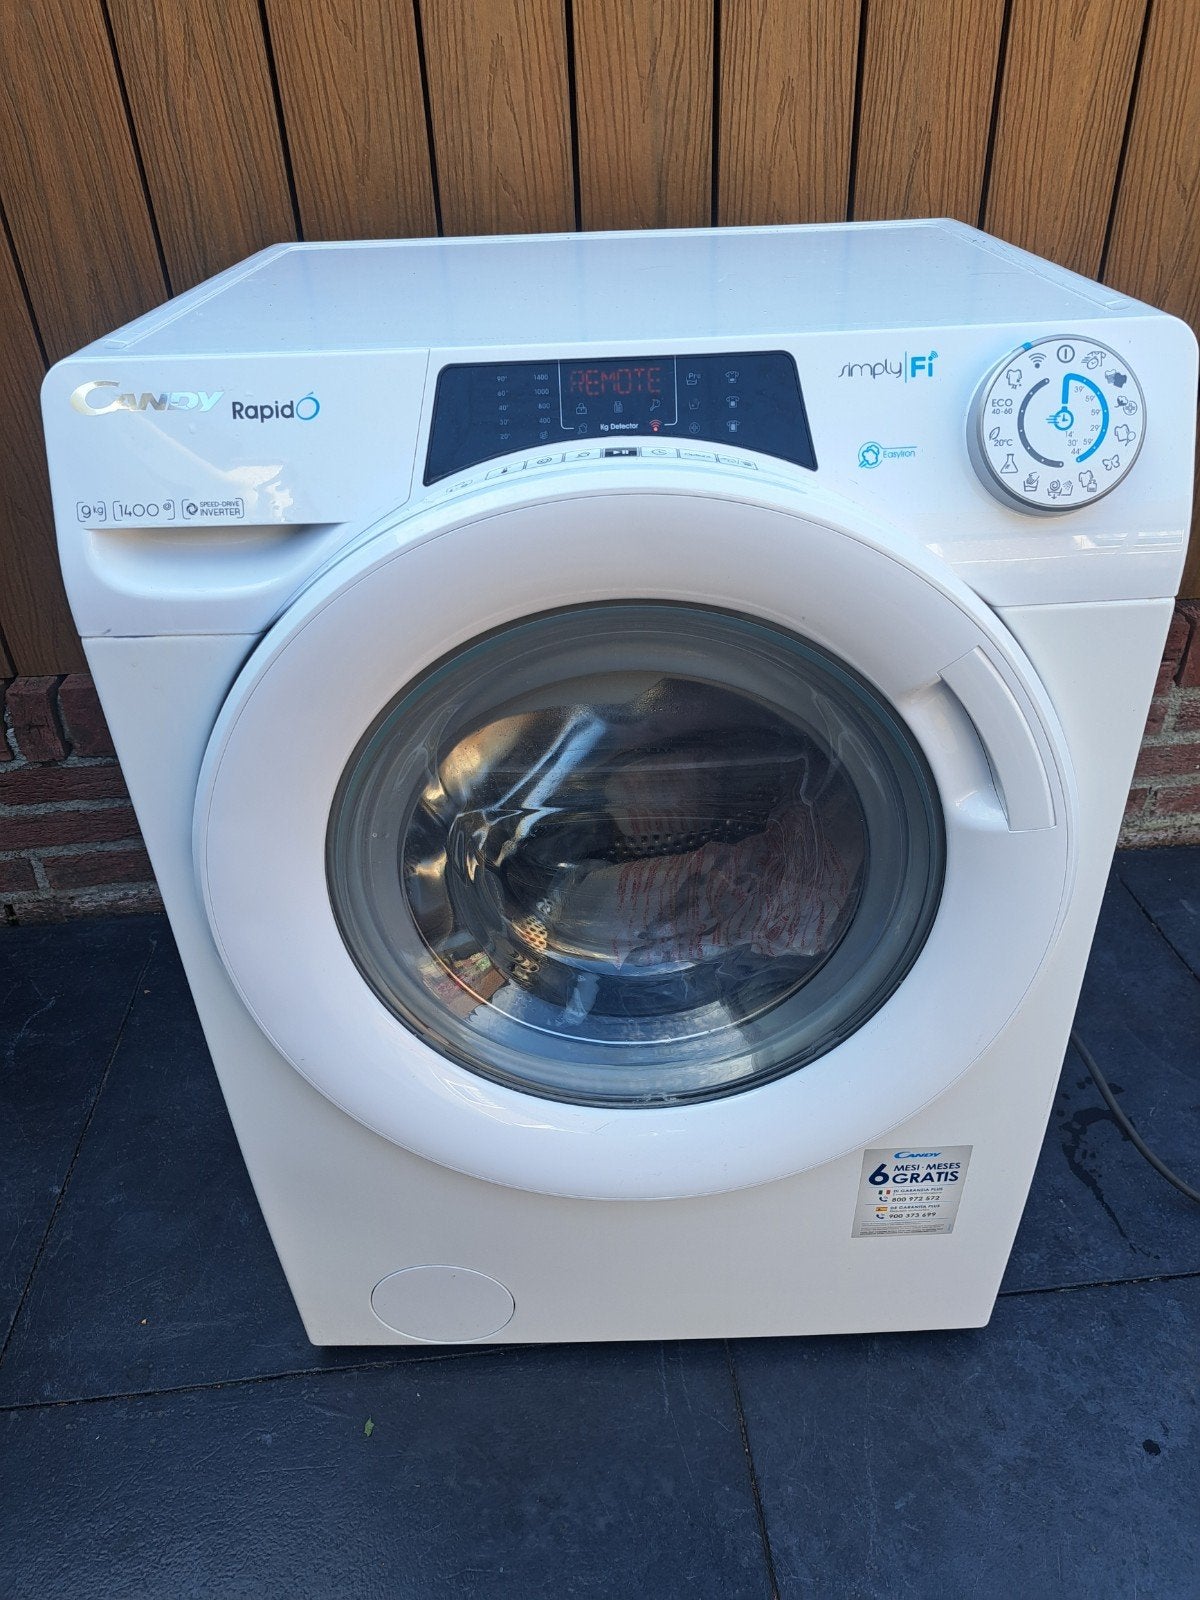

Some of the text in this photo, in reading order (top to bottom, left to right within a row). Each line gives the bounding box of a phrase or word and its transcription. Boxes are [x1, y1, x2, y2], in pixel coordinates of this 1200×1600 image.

[837, 351, 938, 379] simply Fi
[569, 367, 661, 396] REMOTE
[70, 380, 224, 416] CANDY
[991, 398, 1013, 407] ECO
[991, 407, 1013, 415] 40-60
[994, 438, 1013, 446] 20°C
[200, 500, 240, 508] SPEED-DRIVE
[118, 503, 160, 517] 1400
[200, 507, 241, 517] INVERTER
[894, 1151, 942, 1159] CANDY
[893, 1162, 961, 1172] MESI MESES
[868, 1163, 890, 1186] 6
[892, 1170, 960, 1184] GRATIS
